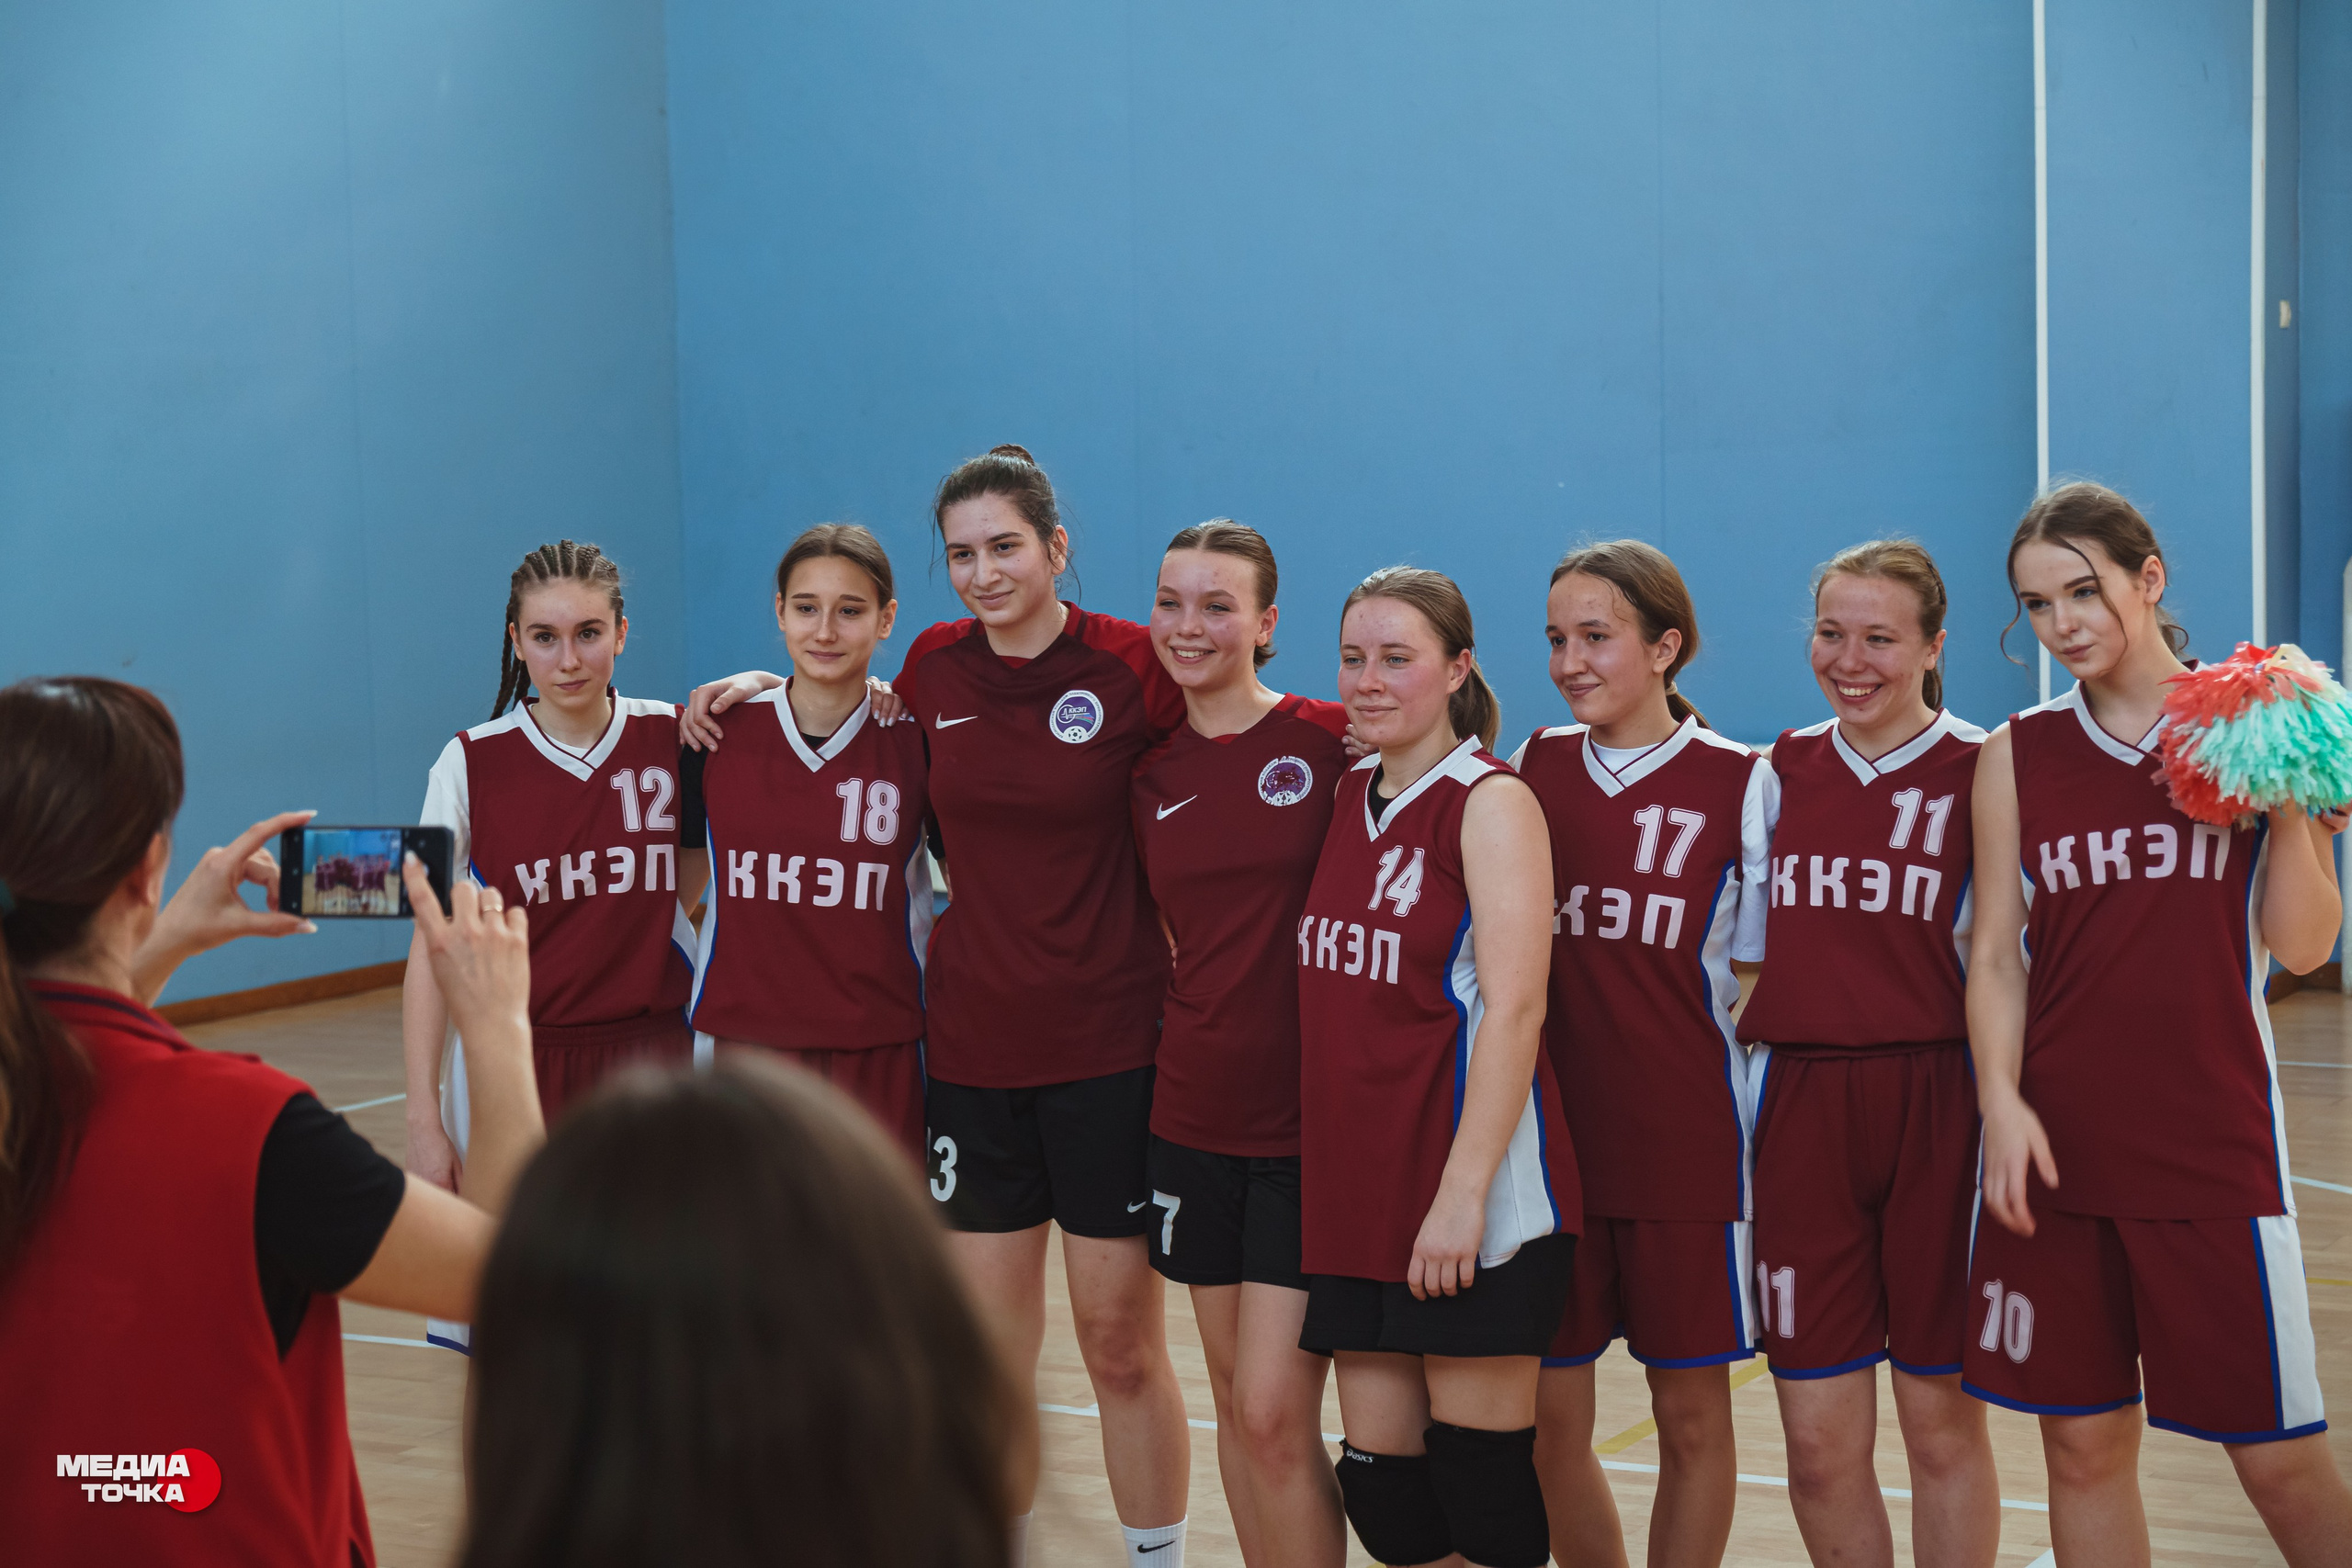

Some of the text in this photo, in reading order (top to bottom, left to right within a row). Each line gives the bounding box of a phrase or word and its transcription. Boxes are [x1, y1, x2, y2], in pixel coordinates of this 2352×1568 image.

[610, 765, 676, 832] 12
[836, 777, 900, 846] 18
[1889, 787, 1954, 856] 11
[514, 843, 676, 906] ККЭП
[1633, 804, 1706, 878] 17
[2039, 823, 2232, 894] ККЭП
[728, 849, 889, 911] ККЭП
[1367, 845, 1425, 917] 14
[1771, 854, 1942, 921] ККЭП
[1552, 885, 1686, 950] КЭП
[927, 1126, 958, 1202] 3
[1152, 1189, 1182, 1256] 7
[1756, 1259, 1795, 1338] 11
[1979, 1279, 2035, 1364] 10
